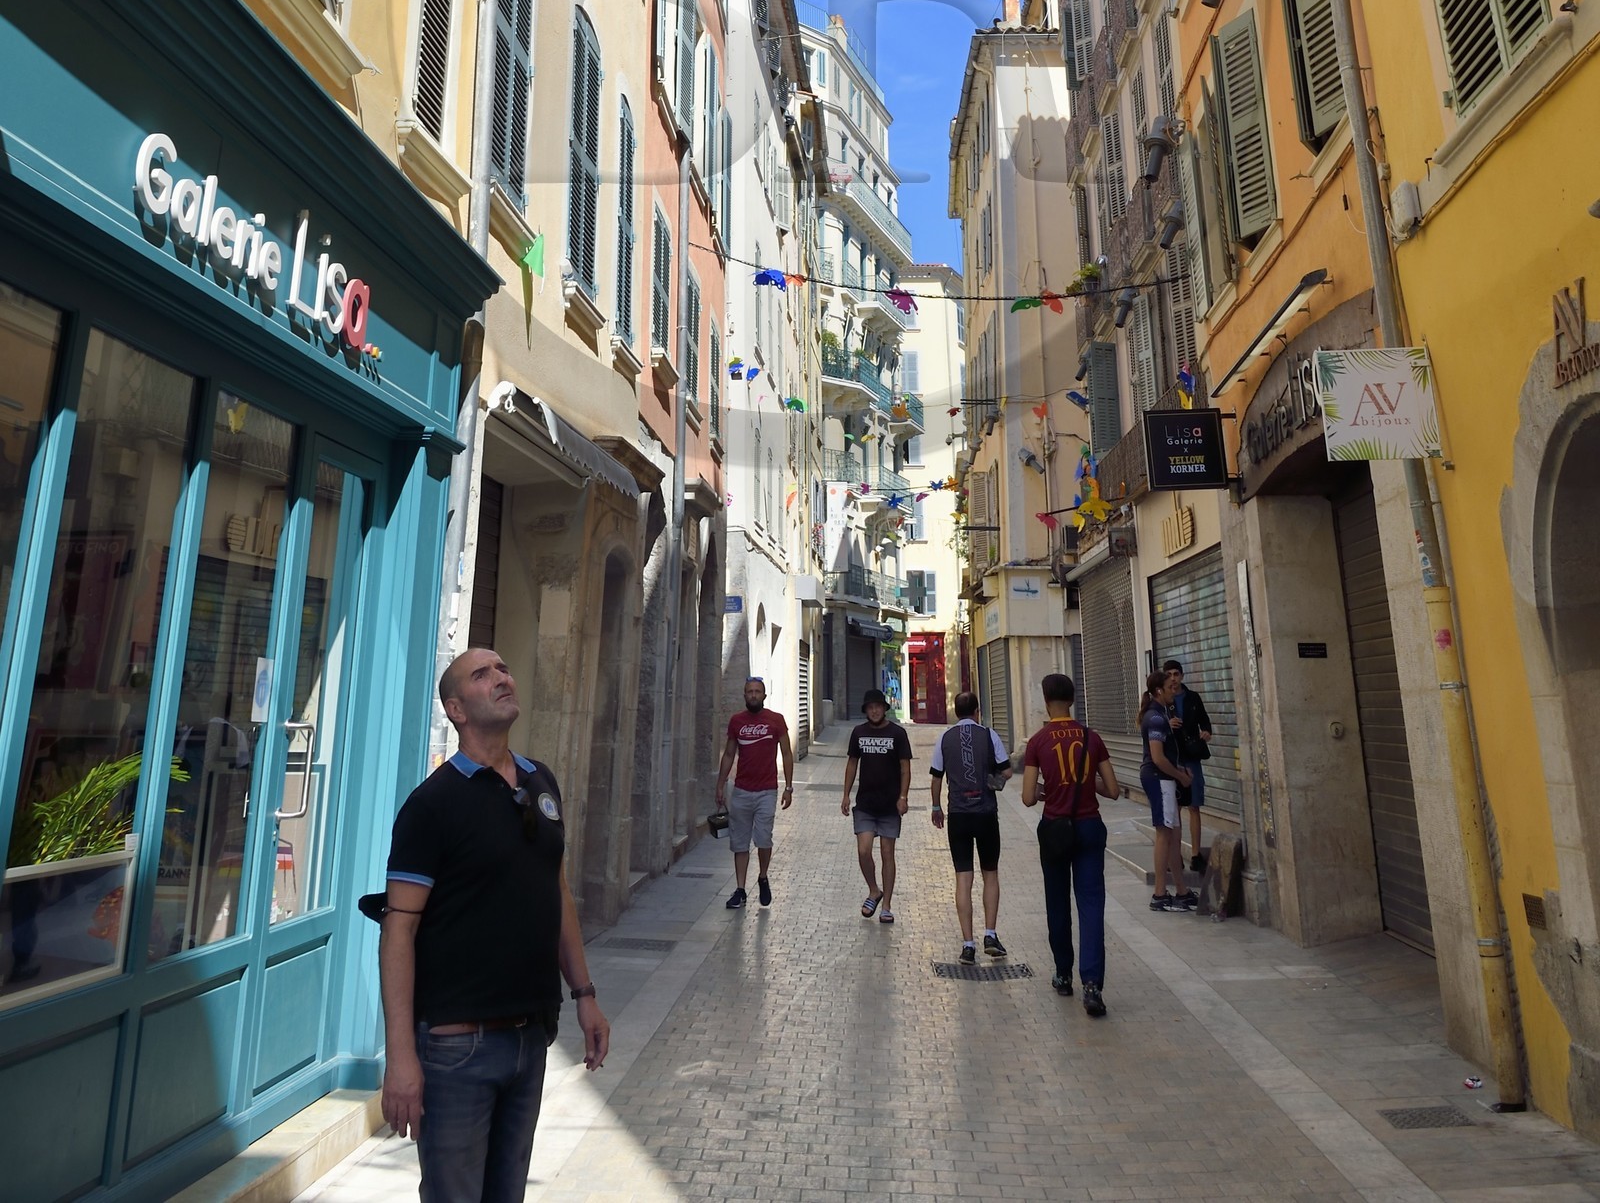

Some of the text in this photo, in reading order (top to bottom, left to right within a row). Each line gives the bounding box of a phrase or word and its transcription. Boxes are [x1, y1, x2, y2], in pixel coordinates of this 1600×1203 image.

[135, 133, 371, 351] Galerie Lisa
[1349, 381, 1407, 426] AV
[1361, 416, 1412, 427] bijoux
[1164, 424, 1202, 438] Lisa
[1246, 398, 1289, 464] Galerie
[1166, 437, 1203, 445] Galerie
[1168, 455, 1205, 465] YELLOW
[1170, 464, 1206, 474] KORNER
[1049, 728, 1084, 740] TOTTI
[858, 736, 895, 748] STRANGER
[862, 746, 888, 754] THINGS
[1051, 740, 1090, 786] 10
